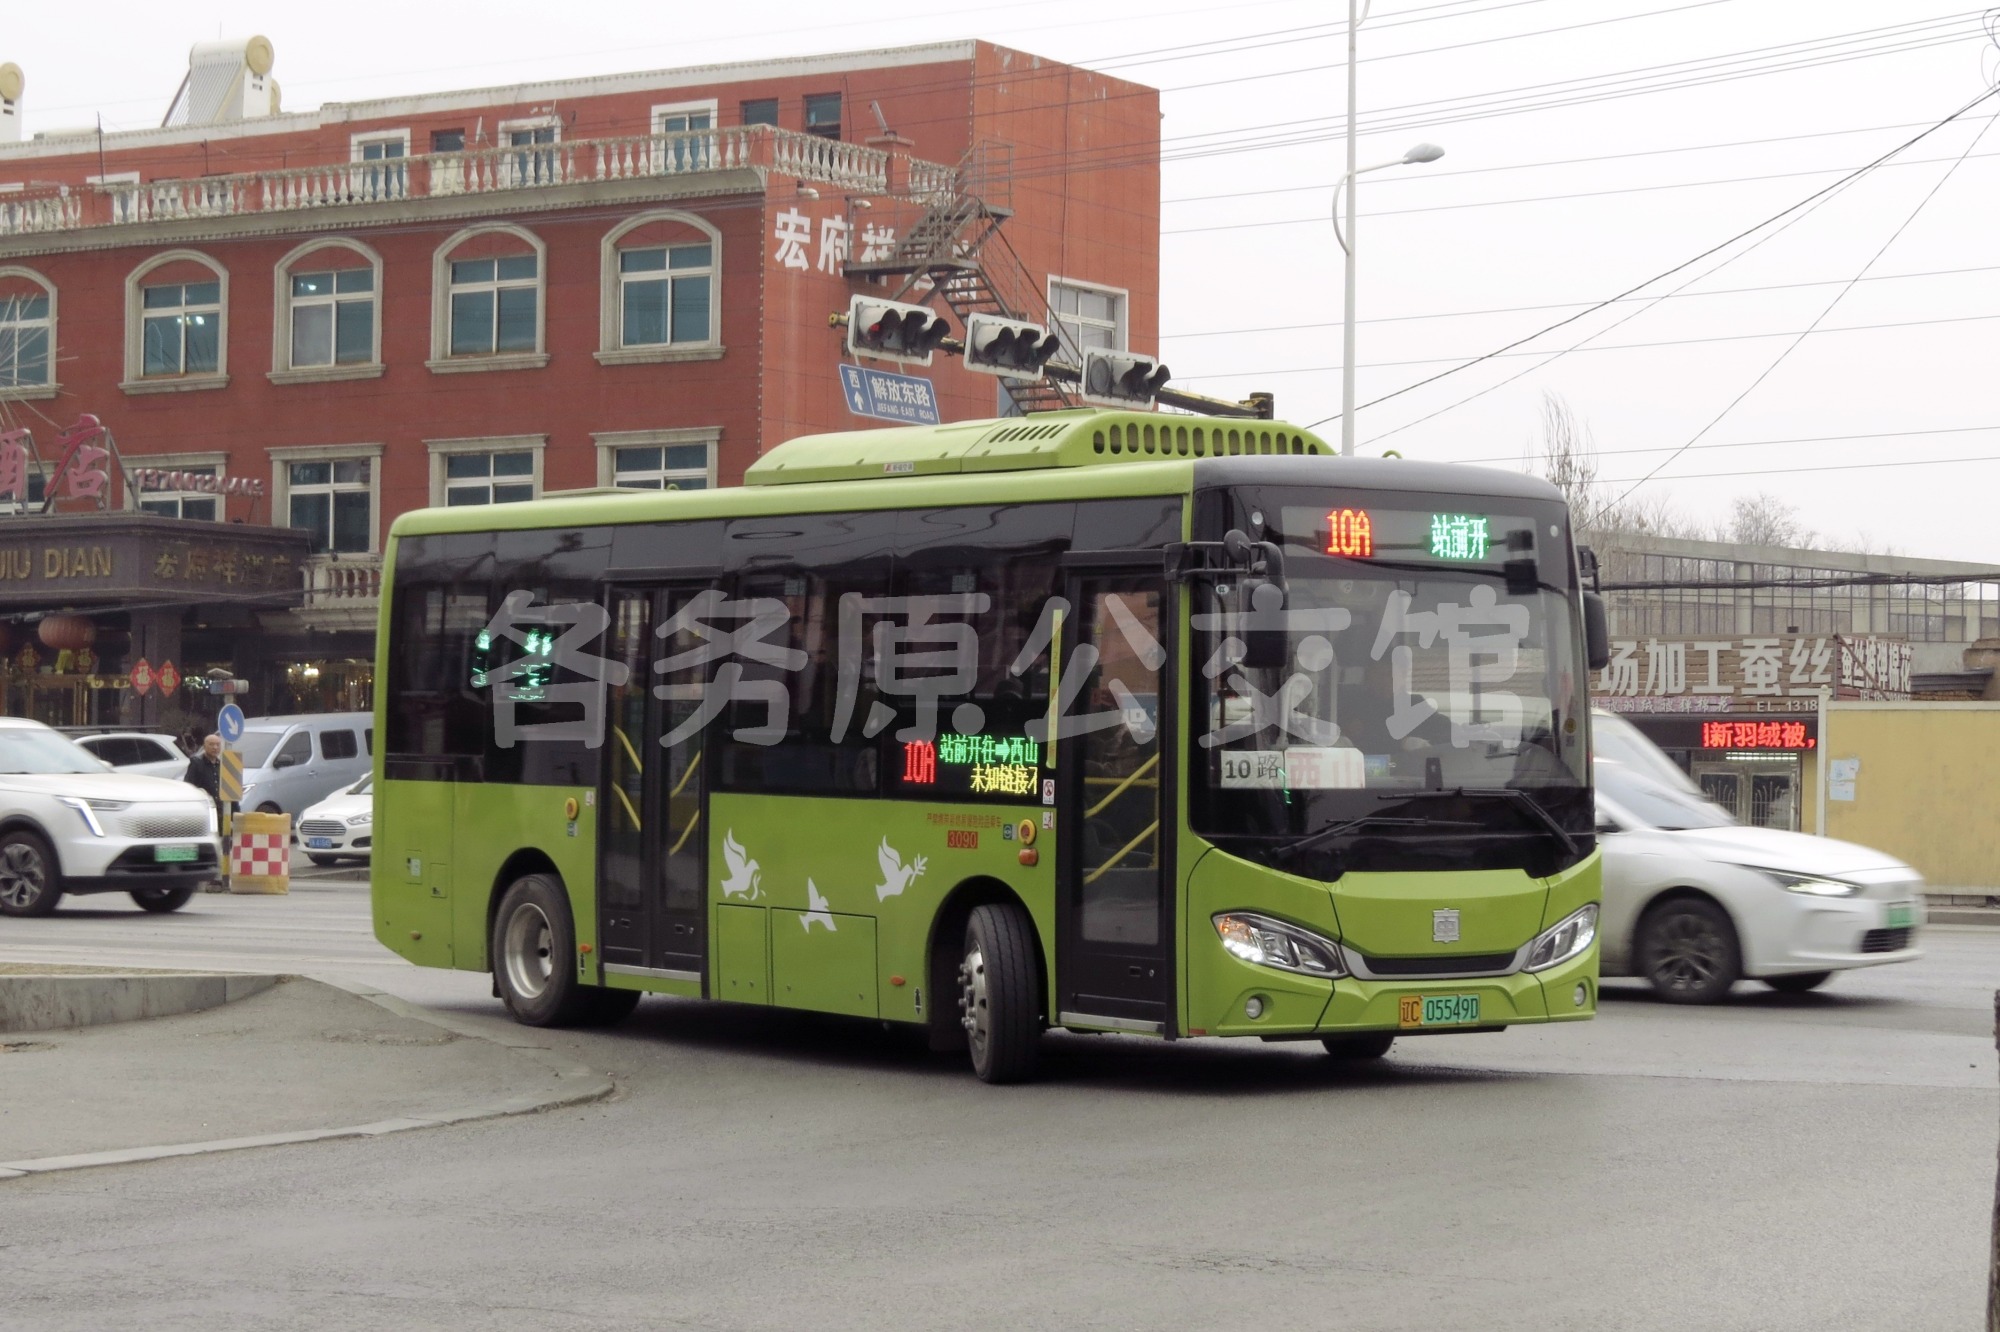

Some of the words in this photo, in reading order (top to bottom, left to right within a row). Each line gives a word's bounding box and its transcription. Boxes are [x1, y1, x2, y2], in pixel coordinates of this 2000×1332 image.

[775, 207, 980, 301] 宏府祥
[848, 369, 860, 388] 西
[871, 376, 930, 407] 解放东路
[877, 402, 899, 415] JIEFANG
[901, 406, 916, 417] EAST
[919, 409, 935, 420] ROAD
[1327, 509, 1372, 557] 10A
[1431, 513, 1489, 559] 站前开
[44, 546, 111, 578] DIAN
[1703, 721, 1817, 749] 新羽绒被，
[903, 739, 936, 784] 10A
[948, 831, 977, 848] 3090
